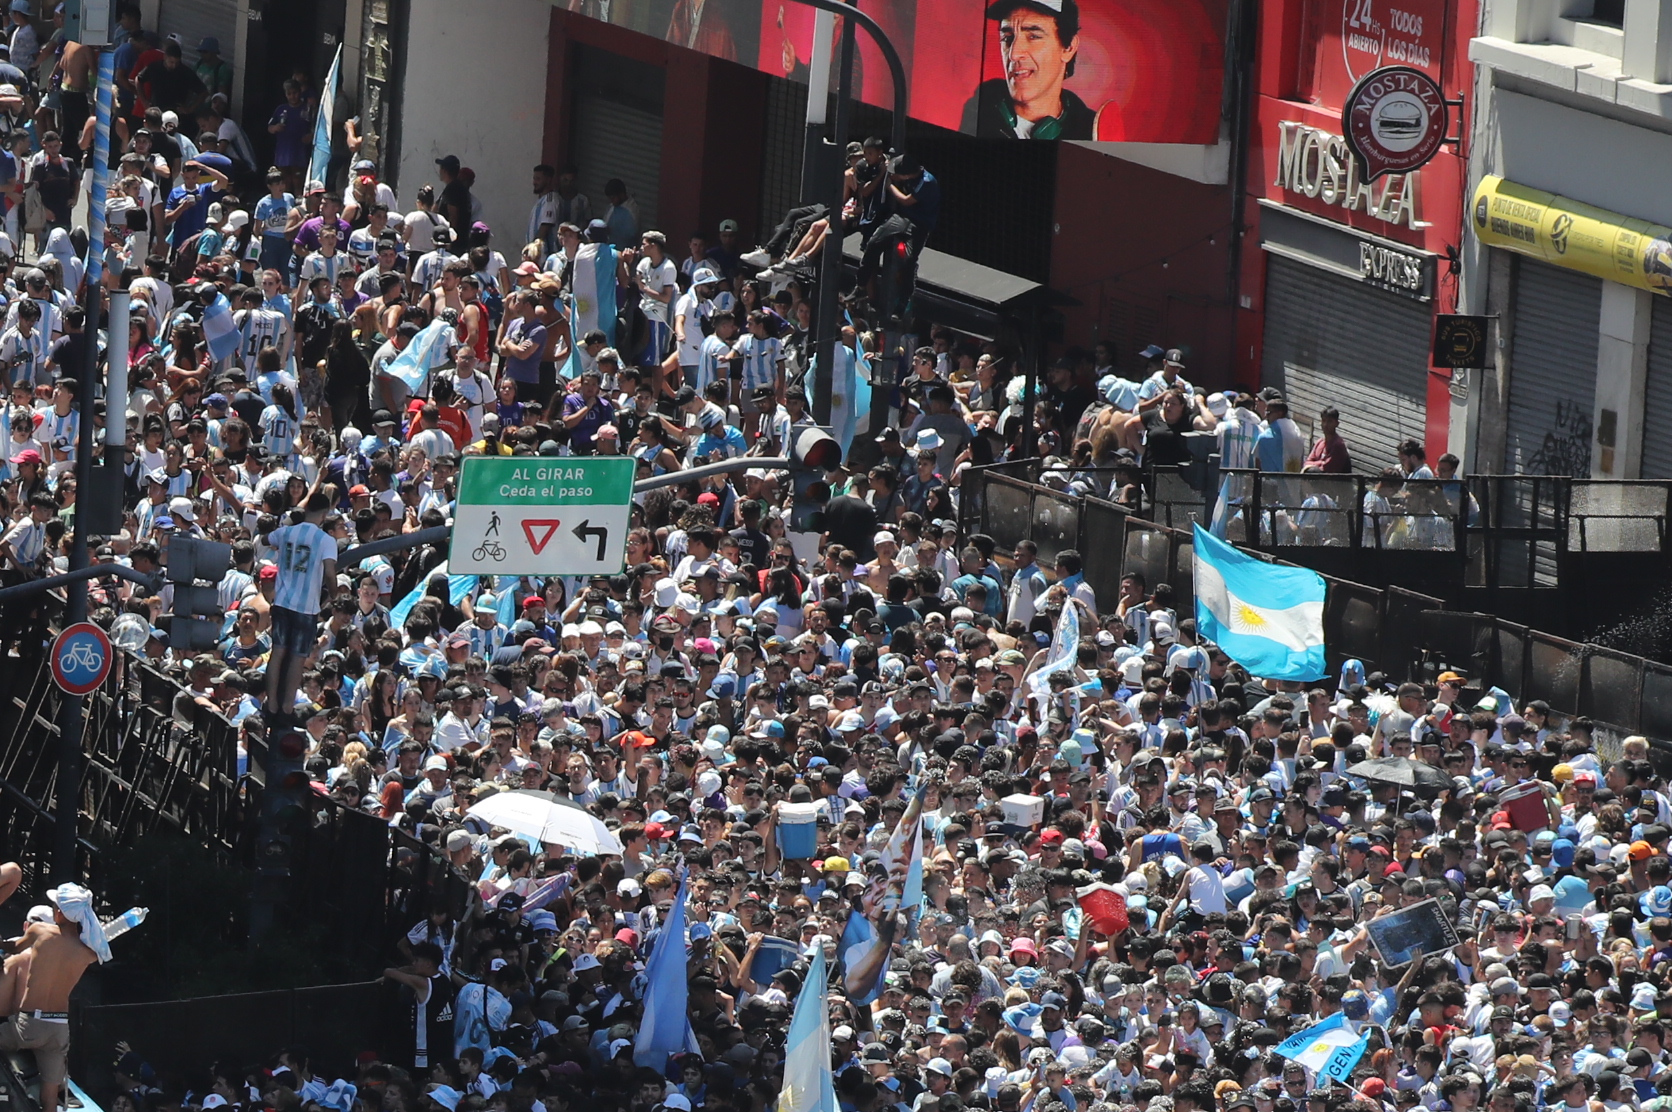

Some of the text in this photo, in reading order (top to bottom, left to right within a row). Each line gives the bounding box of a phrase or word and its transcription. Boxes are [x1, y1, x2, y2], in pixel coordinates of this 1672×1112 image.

[1350, 0, 1372, 31] 24
[1390, 8, 1423, 37] TODOS
[1348, 33, 1379, 56] ABIERTO
[1388, 37, 1430, 68] LOS DÍAS
[1355, 75, 1440, 116] MOSTAZA
[1361, 136, 1409, 164] Hamburguesas
[1410, 153, 1420, 161] en
[1359, 241, 1423, 290] EXPRESS
[255, 322, 273, 330] MESSI
[271, 420, 286, 439] 10
[628, 419, 634, 428] 9
[512, 467, 584, 480] AL GIRAR
[499, 484, 593, 499] Ceda el paso
[285, 542, 311, 573] 12
[1431, 907, 1456, 944] SMARTLIFE
